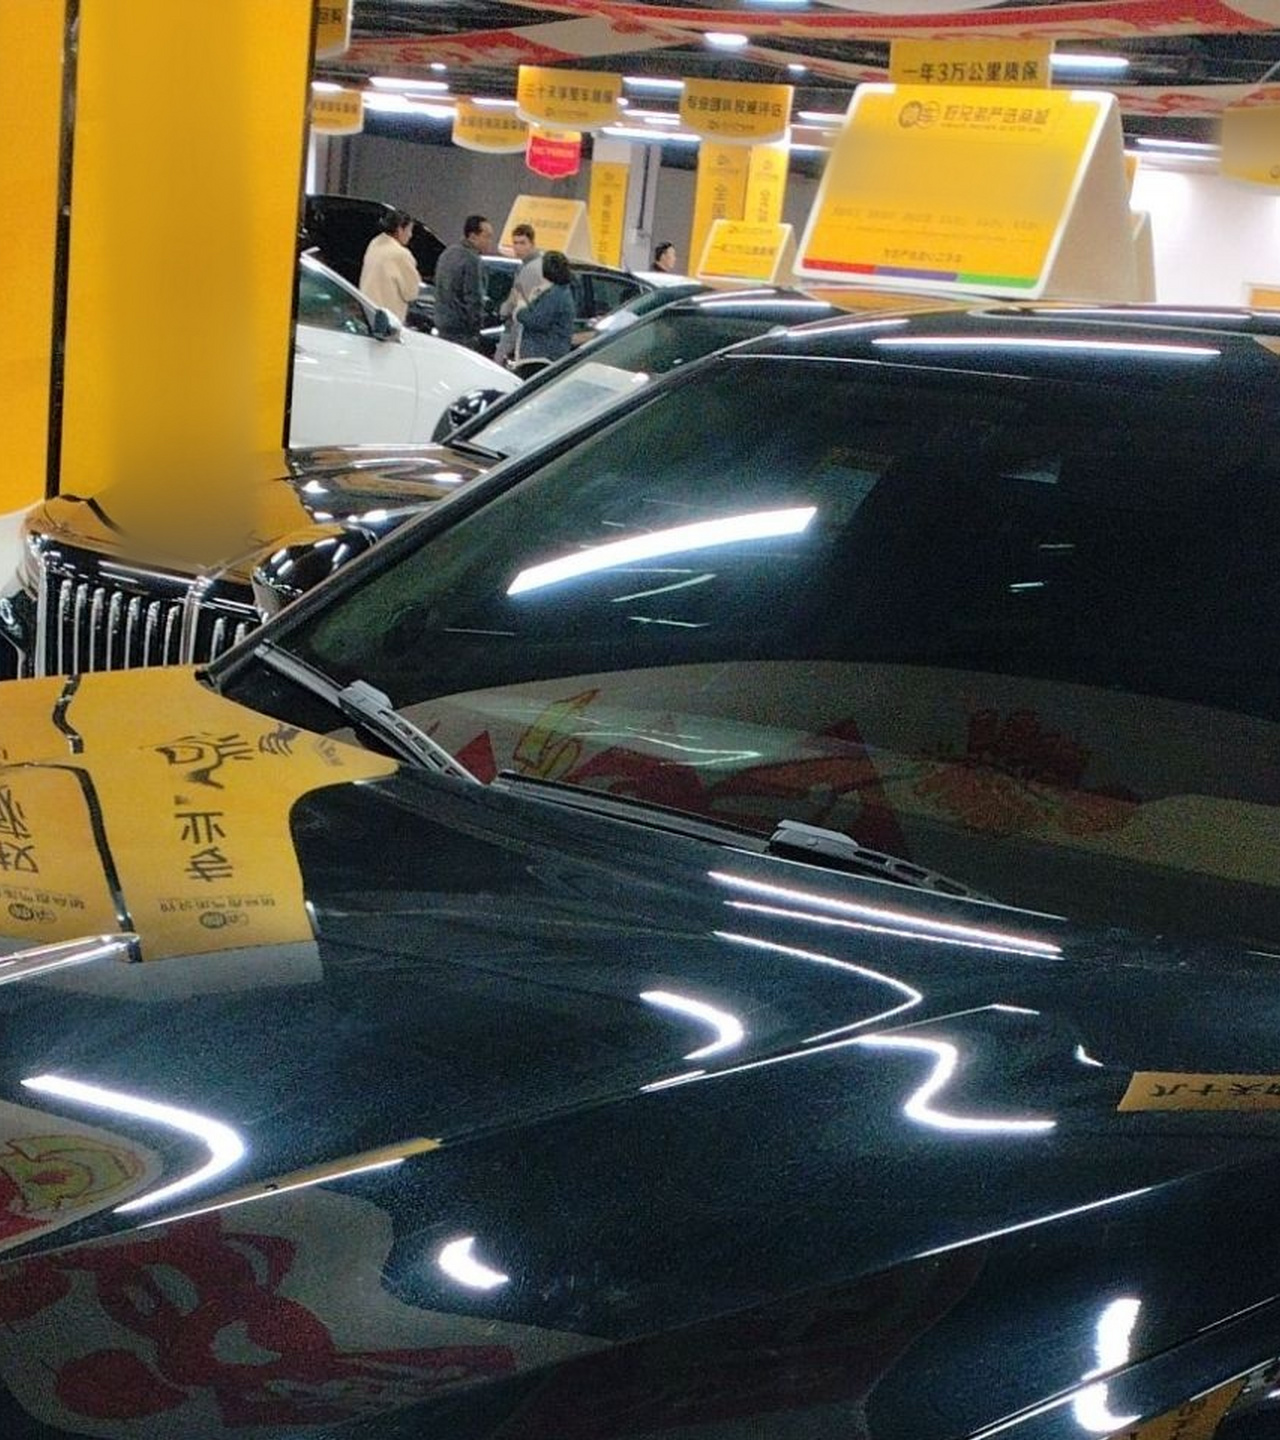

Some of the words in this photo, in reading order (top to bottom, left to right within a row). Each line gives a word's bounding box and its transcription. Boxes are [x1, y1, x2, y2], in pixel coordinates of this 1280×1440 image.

[902, 60, 1039, 82] 一年3万公里质保
